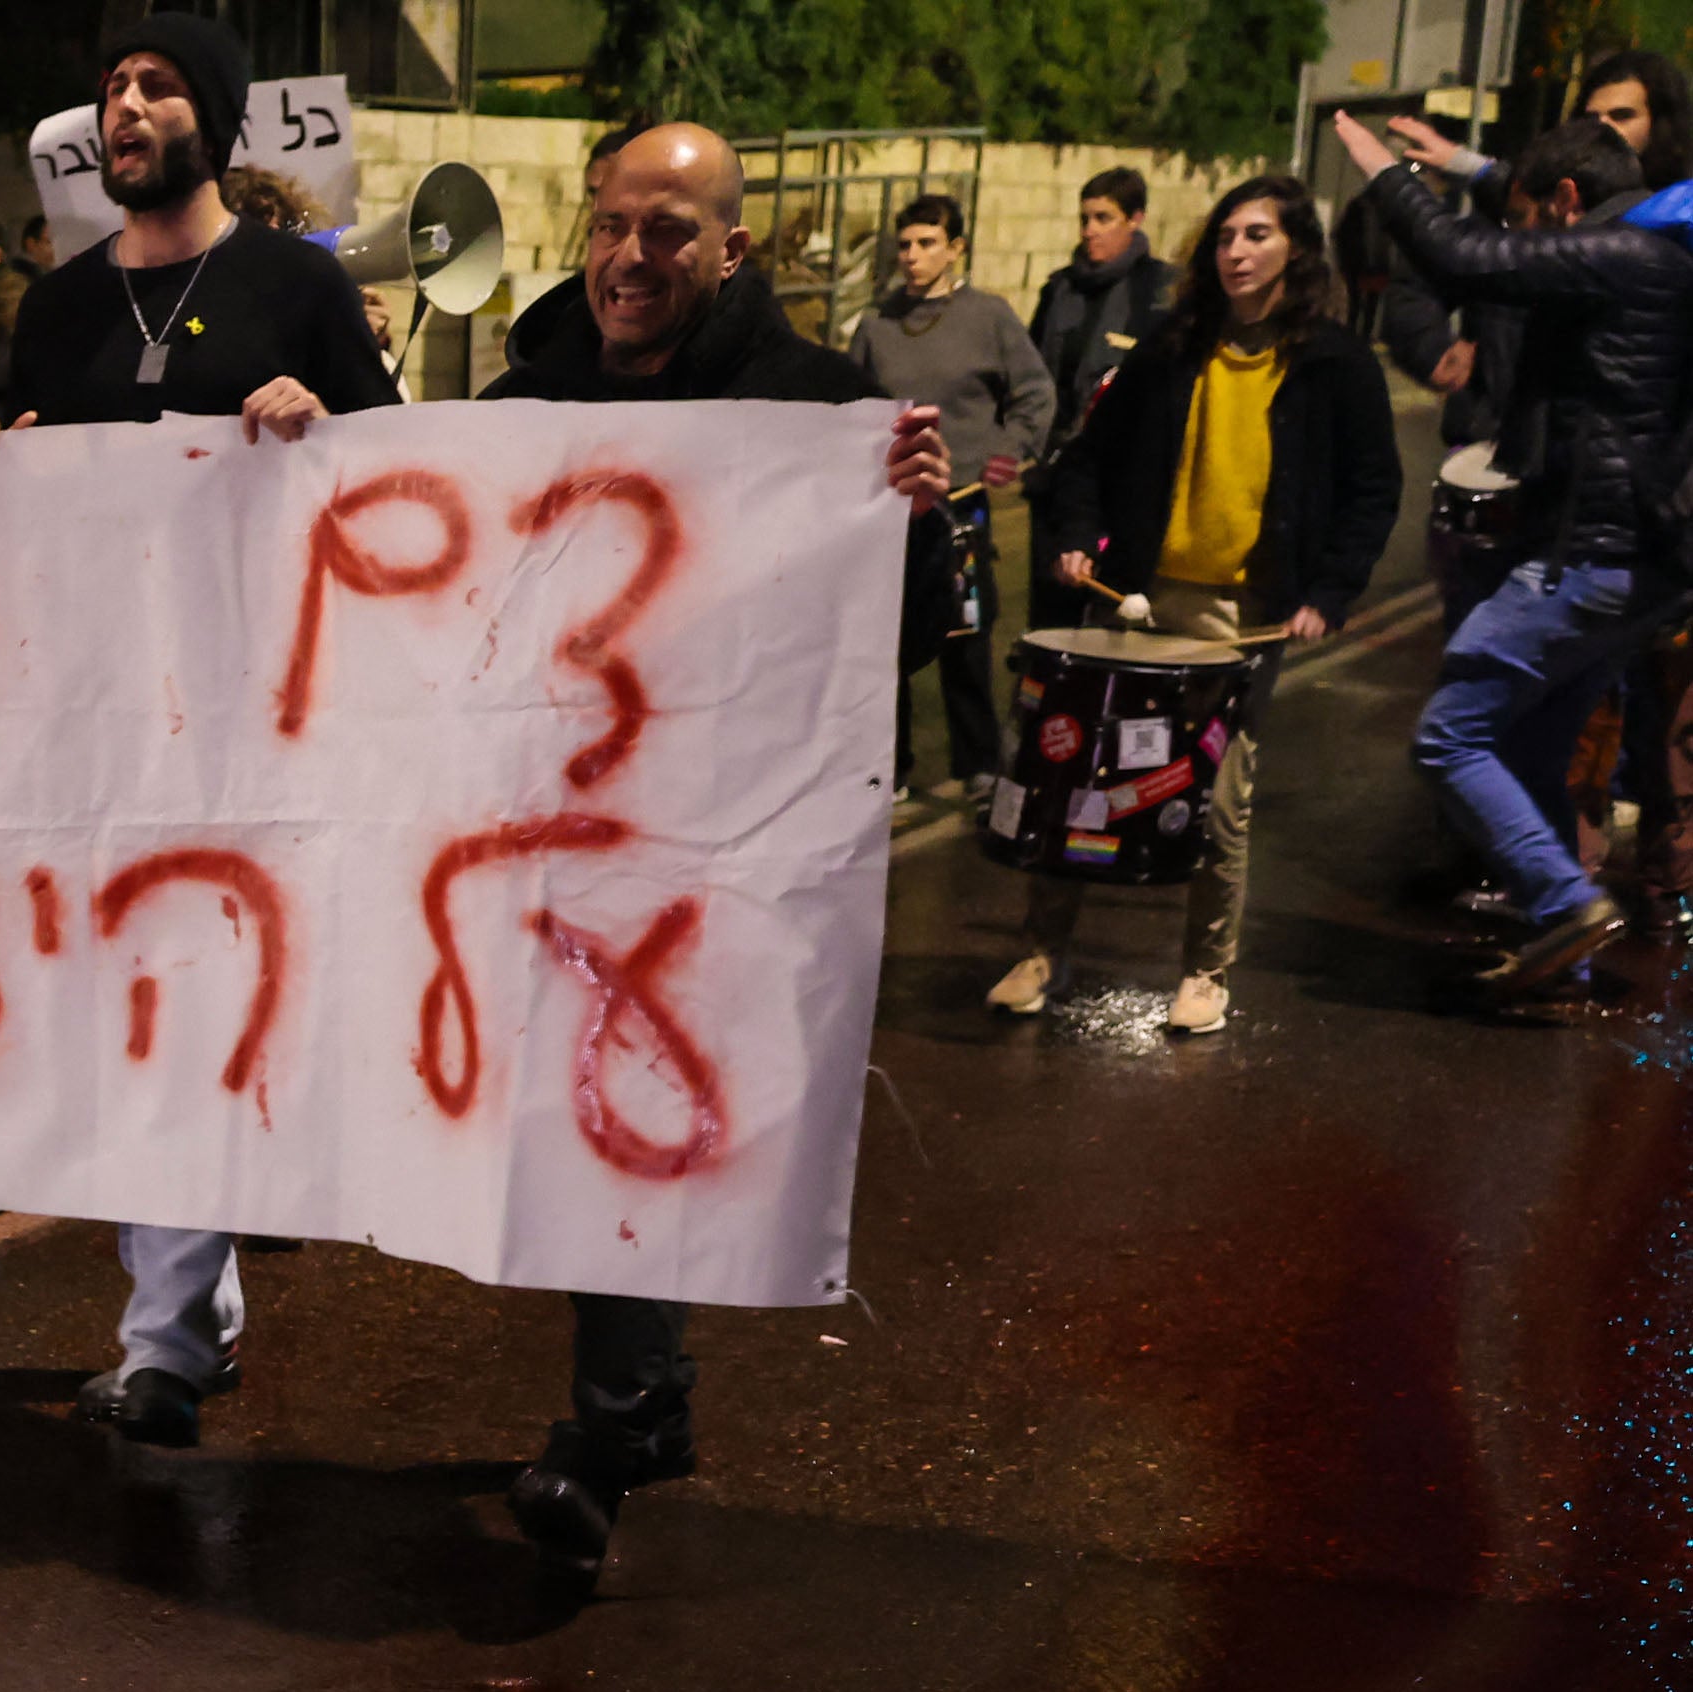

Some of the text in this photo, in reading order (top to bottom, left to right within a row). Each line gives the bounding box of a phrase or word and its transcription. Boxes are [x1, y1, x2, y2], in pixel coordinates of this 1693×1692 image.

[281, 88, 342, 152] כל
[272, 465, 687, 792] דם
[413, 812, 733, 1186] על
